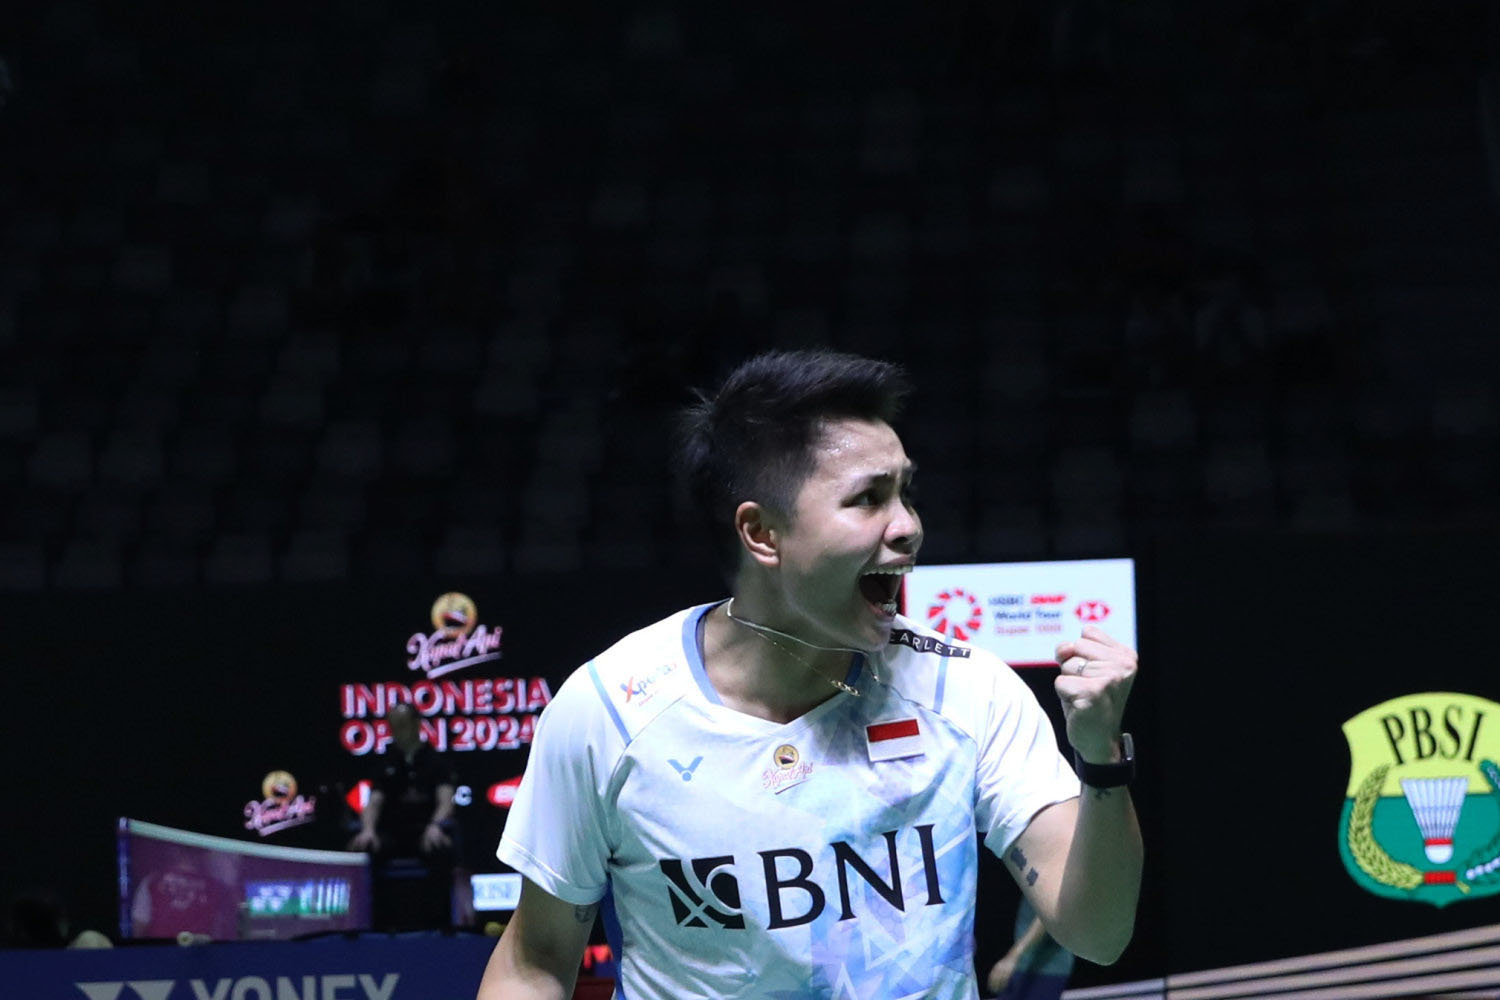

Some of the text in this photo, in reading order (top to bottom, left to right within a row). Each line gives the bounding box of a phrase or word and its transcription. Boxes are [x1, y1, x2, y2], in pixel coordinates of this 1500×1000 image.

[340, 675, 553, 720] INDONESIA
[340, 716, 447, 756] OPN
[1380, 704, 1486, 765] PBSI
[757, 823, 947, 930] BNI
